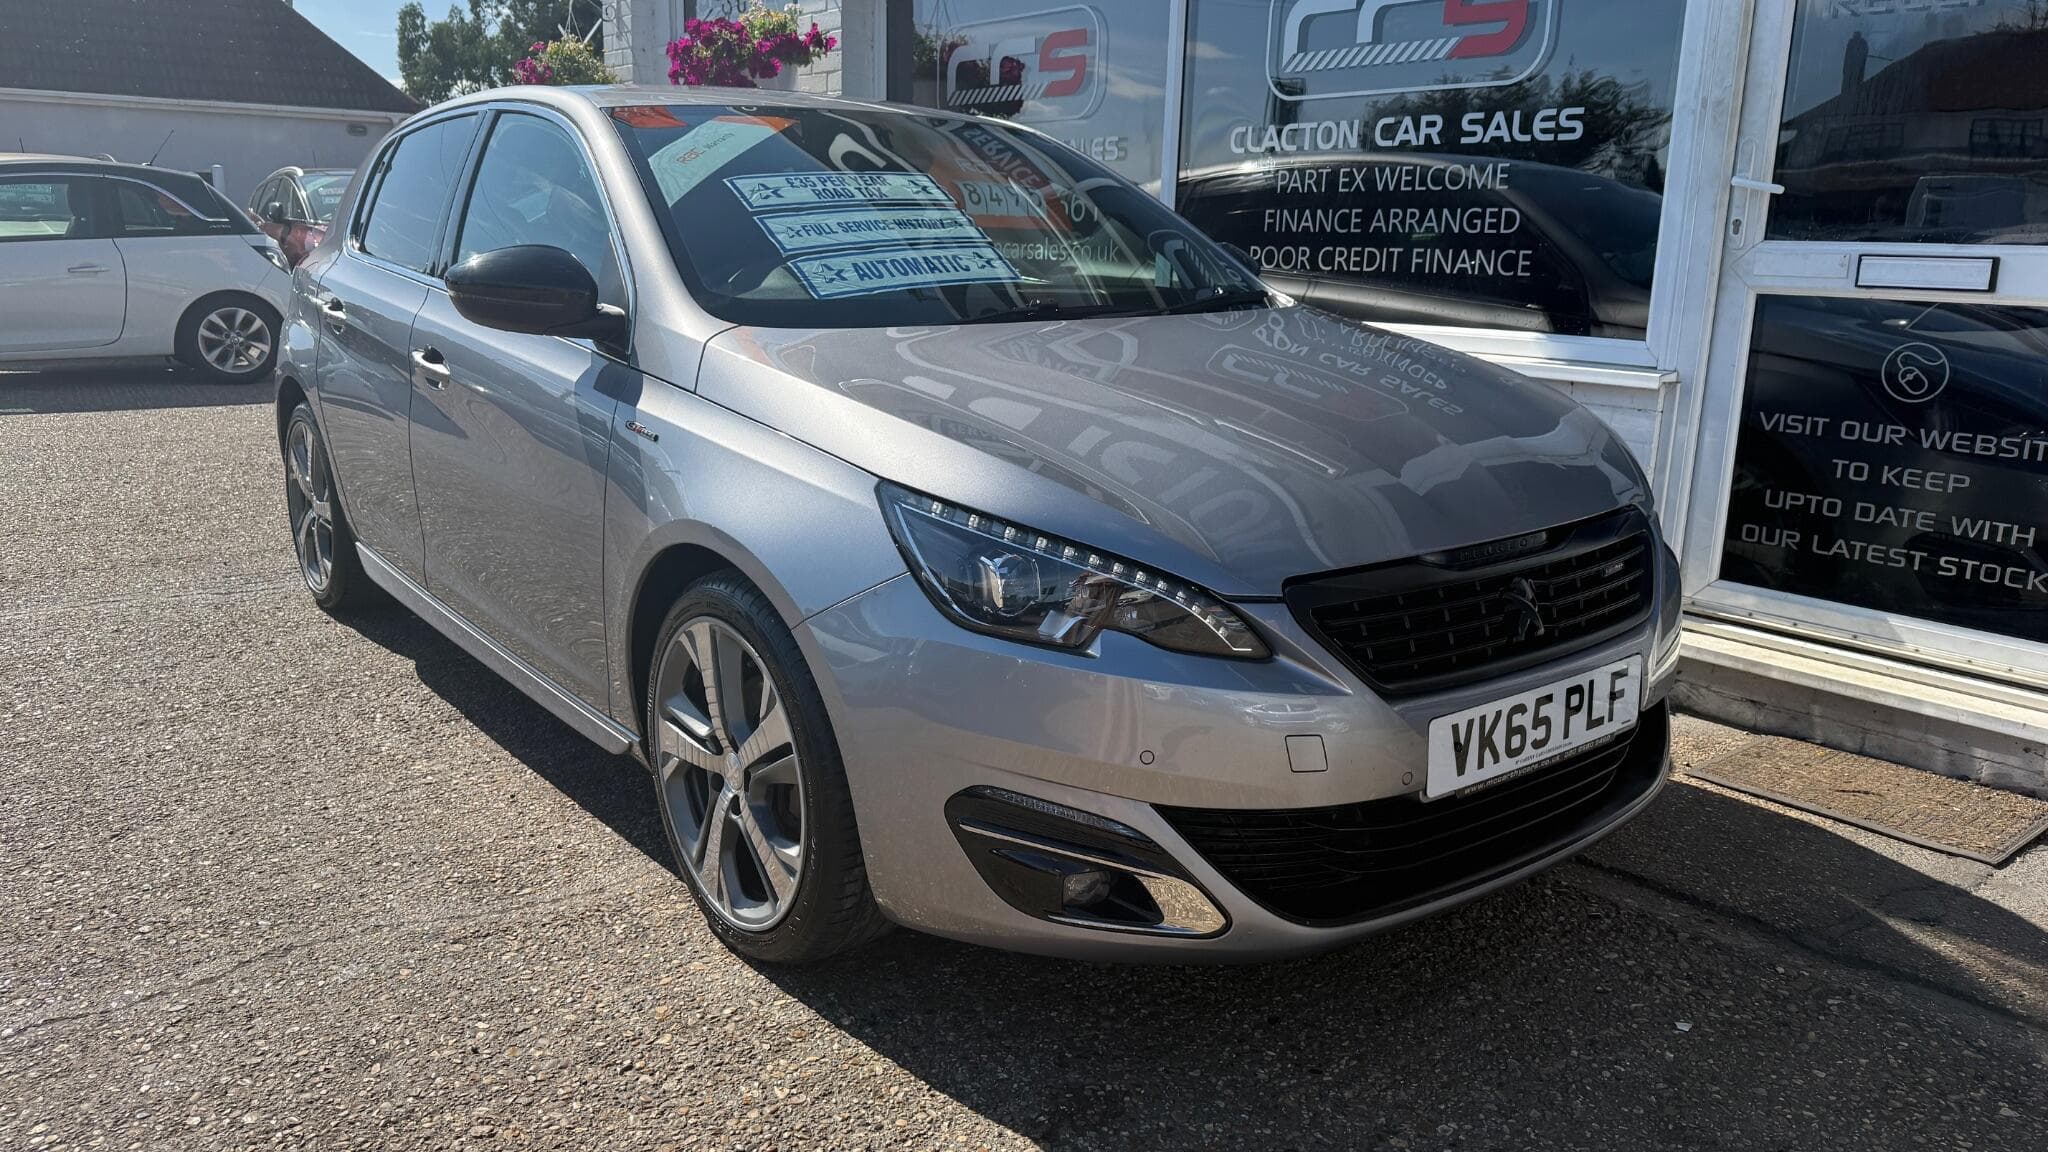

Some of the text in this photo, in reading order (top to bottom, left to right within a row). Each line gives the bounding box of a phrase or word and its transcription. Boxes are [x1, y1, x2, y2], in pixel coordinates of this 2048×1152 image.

[1229, 106, 1586, 154] CLACTON CAR SALES
[785, 174, 889, 189] £35 PER YEAR
[813, 186, 888, 200] ROAD TAX
[1276, 162, 1511, 194] PART EX WELCOME
[802, 217, 946, 237] FULL SERVICE HISTORY
[1263, 207, 1521, 234] FINANCE ARRANGED
[853, 254, 971, 282] AUTOMATIC
[1249, 245, 1533, 278] POOR CREDIT FINANCE
[1758, 410, 1830, 437] VISIT
[1840, 418, 1906, 446] OUR
[1832, 457, 1970, 495] TO KEEP
[1765, 488, 2036, 549] UPTO DATE WITH
[1741, 523, 2048, 594] OUR LATEST STOCK
[1452, 665, 1629, 777] VK65 PLF
